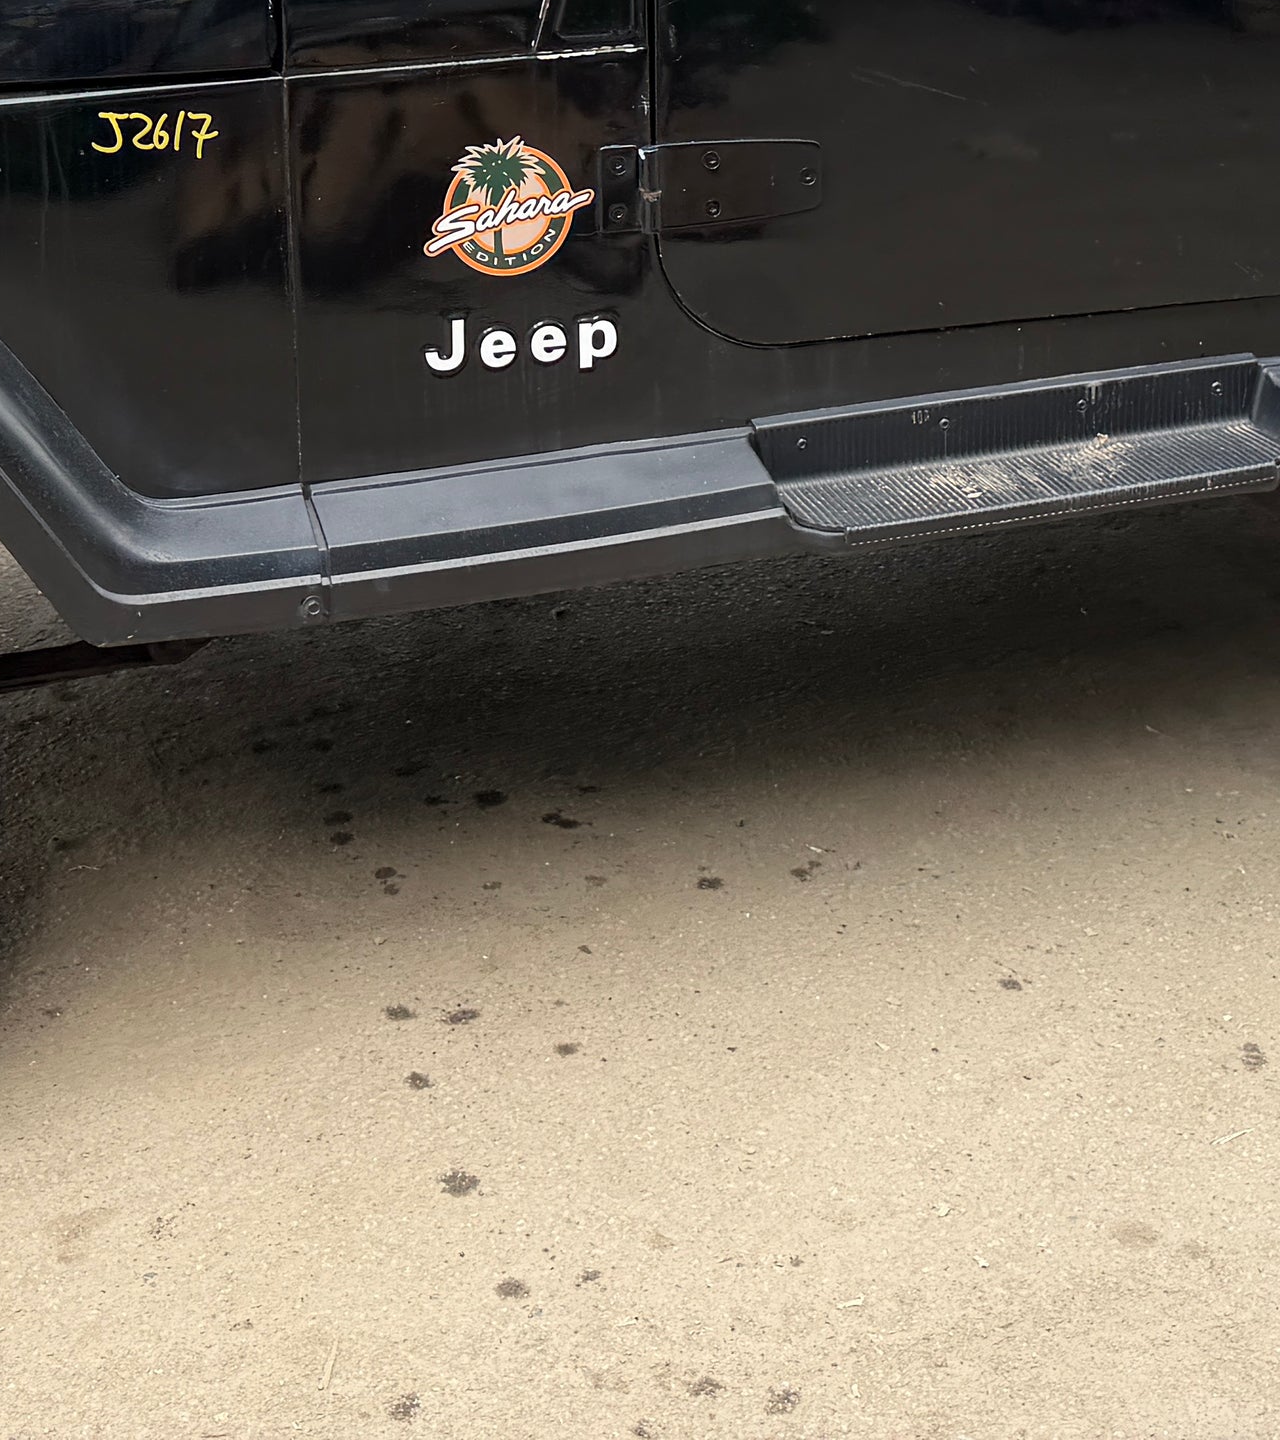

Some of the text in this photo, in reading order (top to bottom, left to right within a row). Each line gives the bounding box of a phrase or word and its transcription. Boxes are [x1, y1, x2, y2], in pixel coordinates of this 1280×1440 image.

[91, 111, 219, 160] J2617
[426, 186, 593, 254] Sahara
[462, 227, 557, 267] EDITION
[424, 318, 619, 372] Jeep
